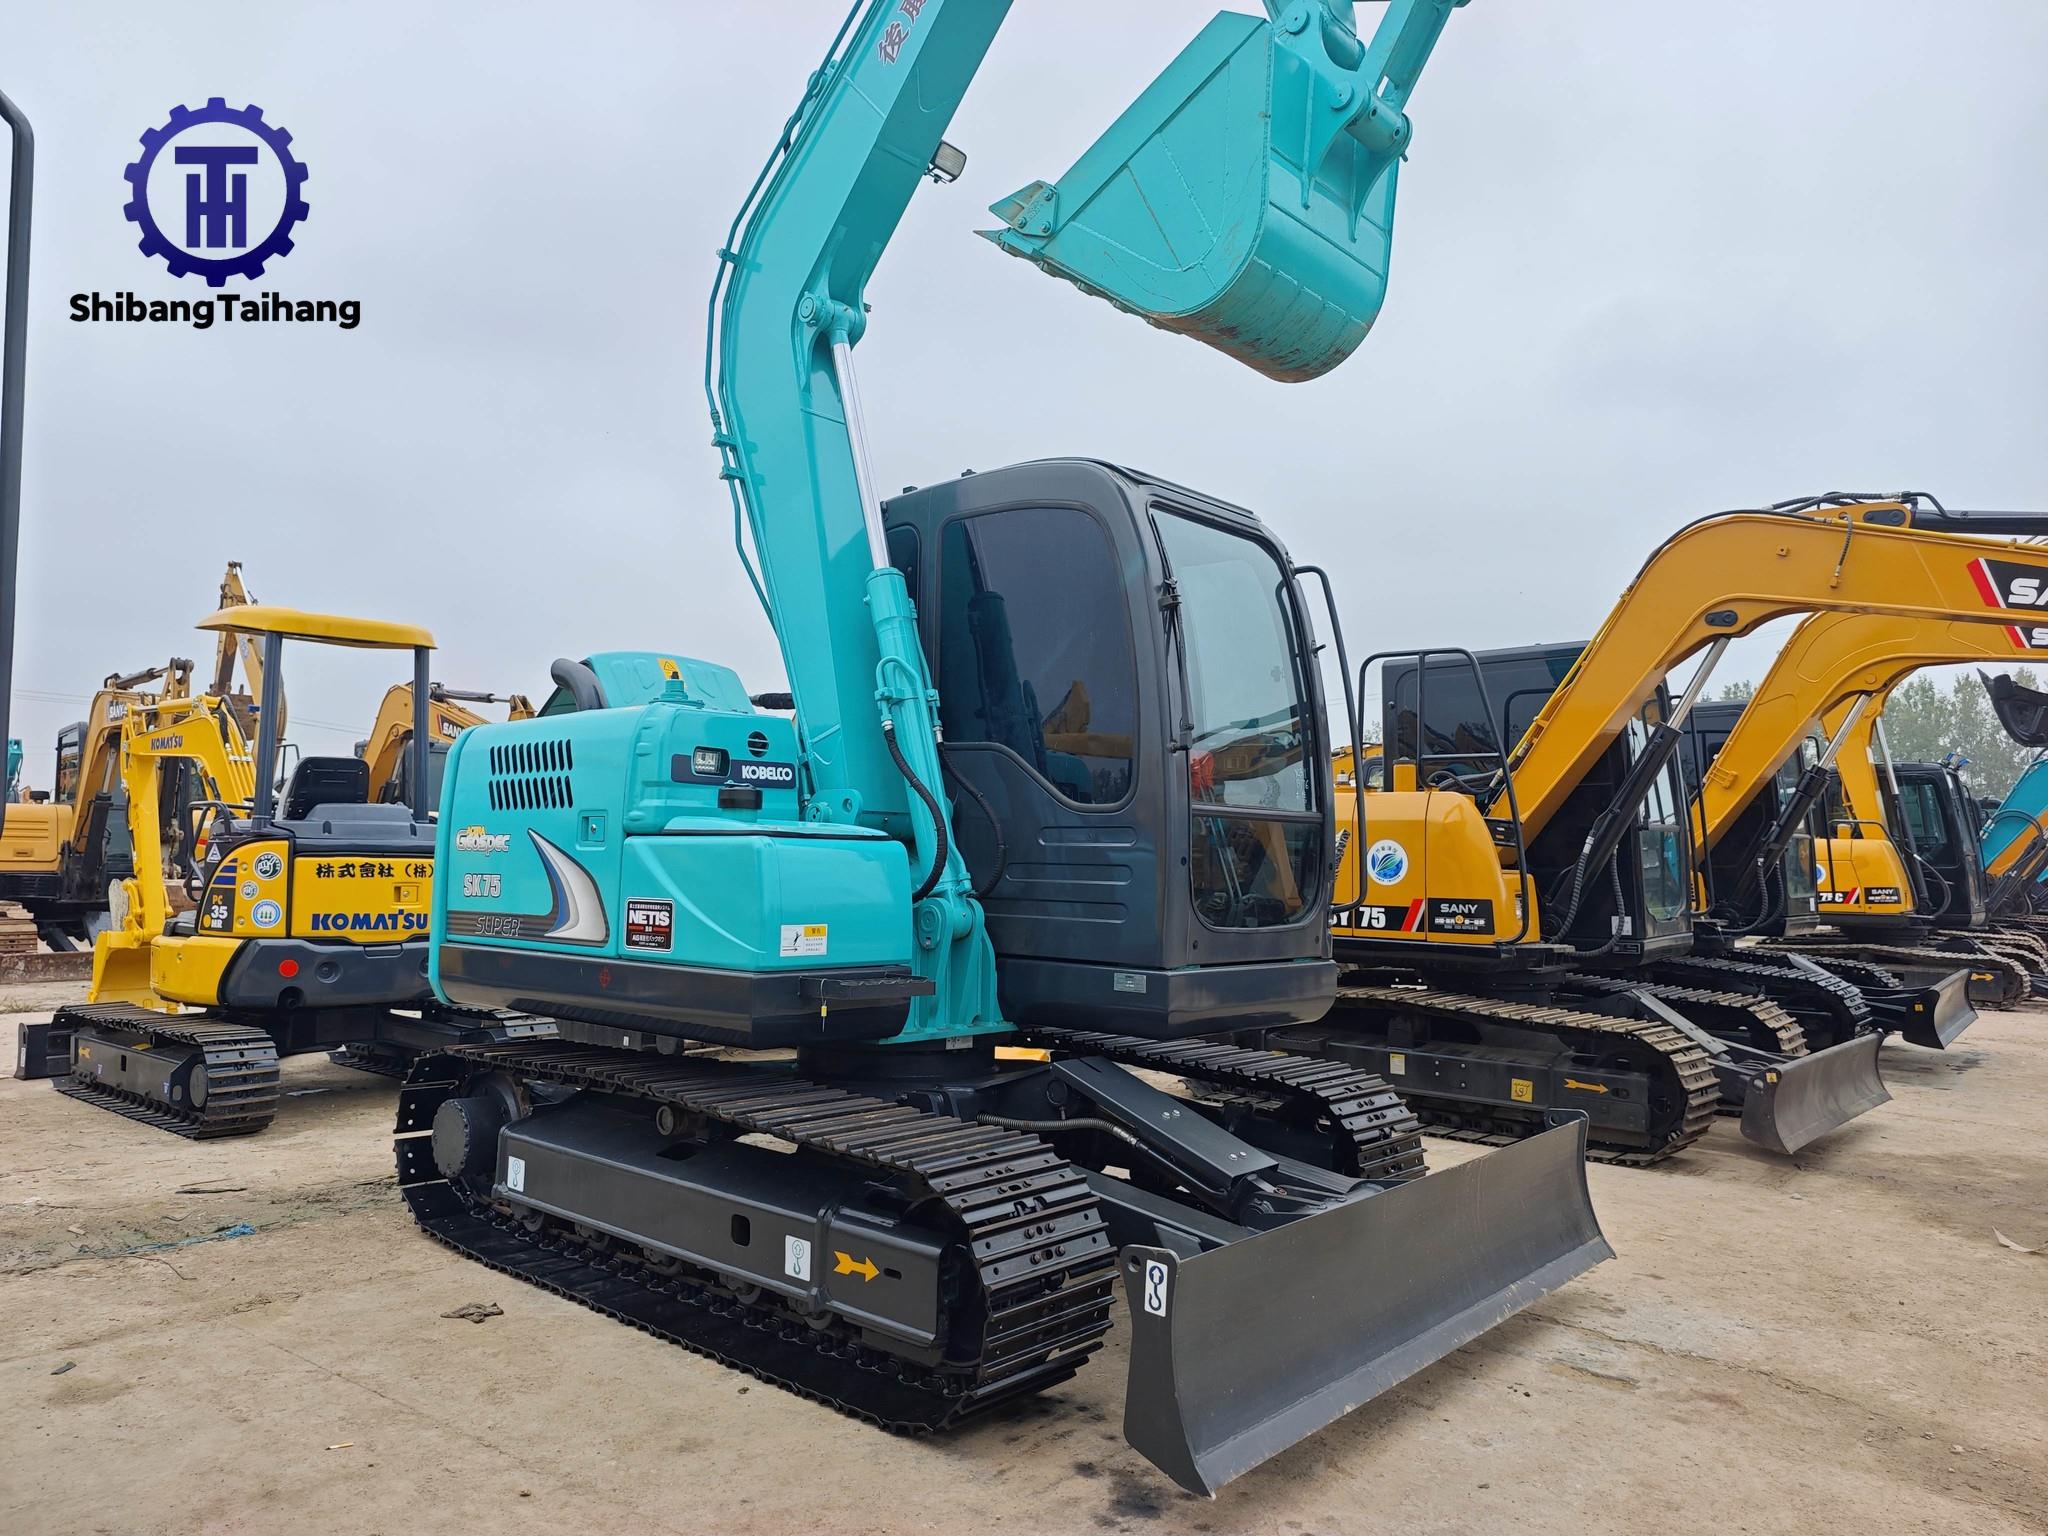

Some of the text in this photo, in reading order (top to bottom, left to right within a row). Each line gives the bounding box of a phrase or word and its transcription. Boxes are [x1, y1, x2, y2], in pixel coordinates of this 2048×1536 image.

[741, 765, 793, 781] KOBELCO
[212, 894, 223, 905] PC
[211, 905, 228, 919] 35
[1440, 903, 1478, 914] SANY
[311, 908, 428, 931] KOMATSU
[629, 910, 670, 926] NETIS
[1358, 906, 1386, 928] 75
[475, 915, 520, 937] SUPER
